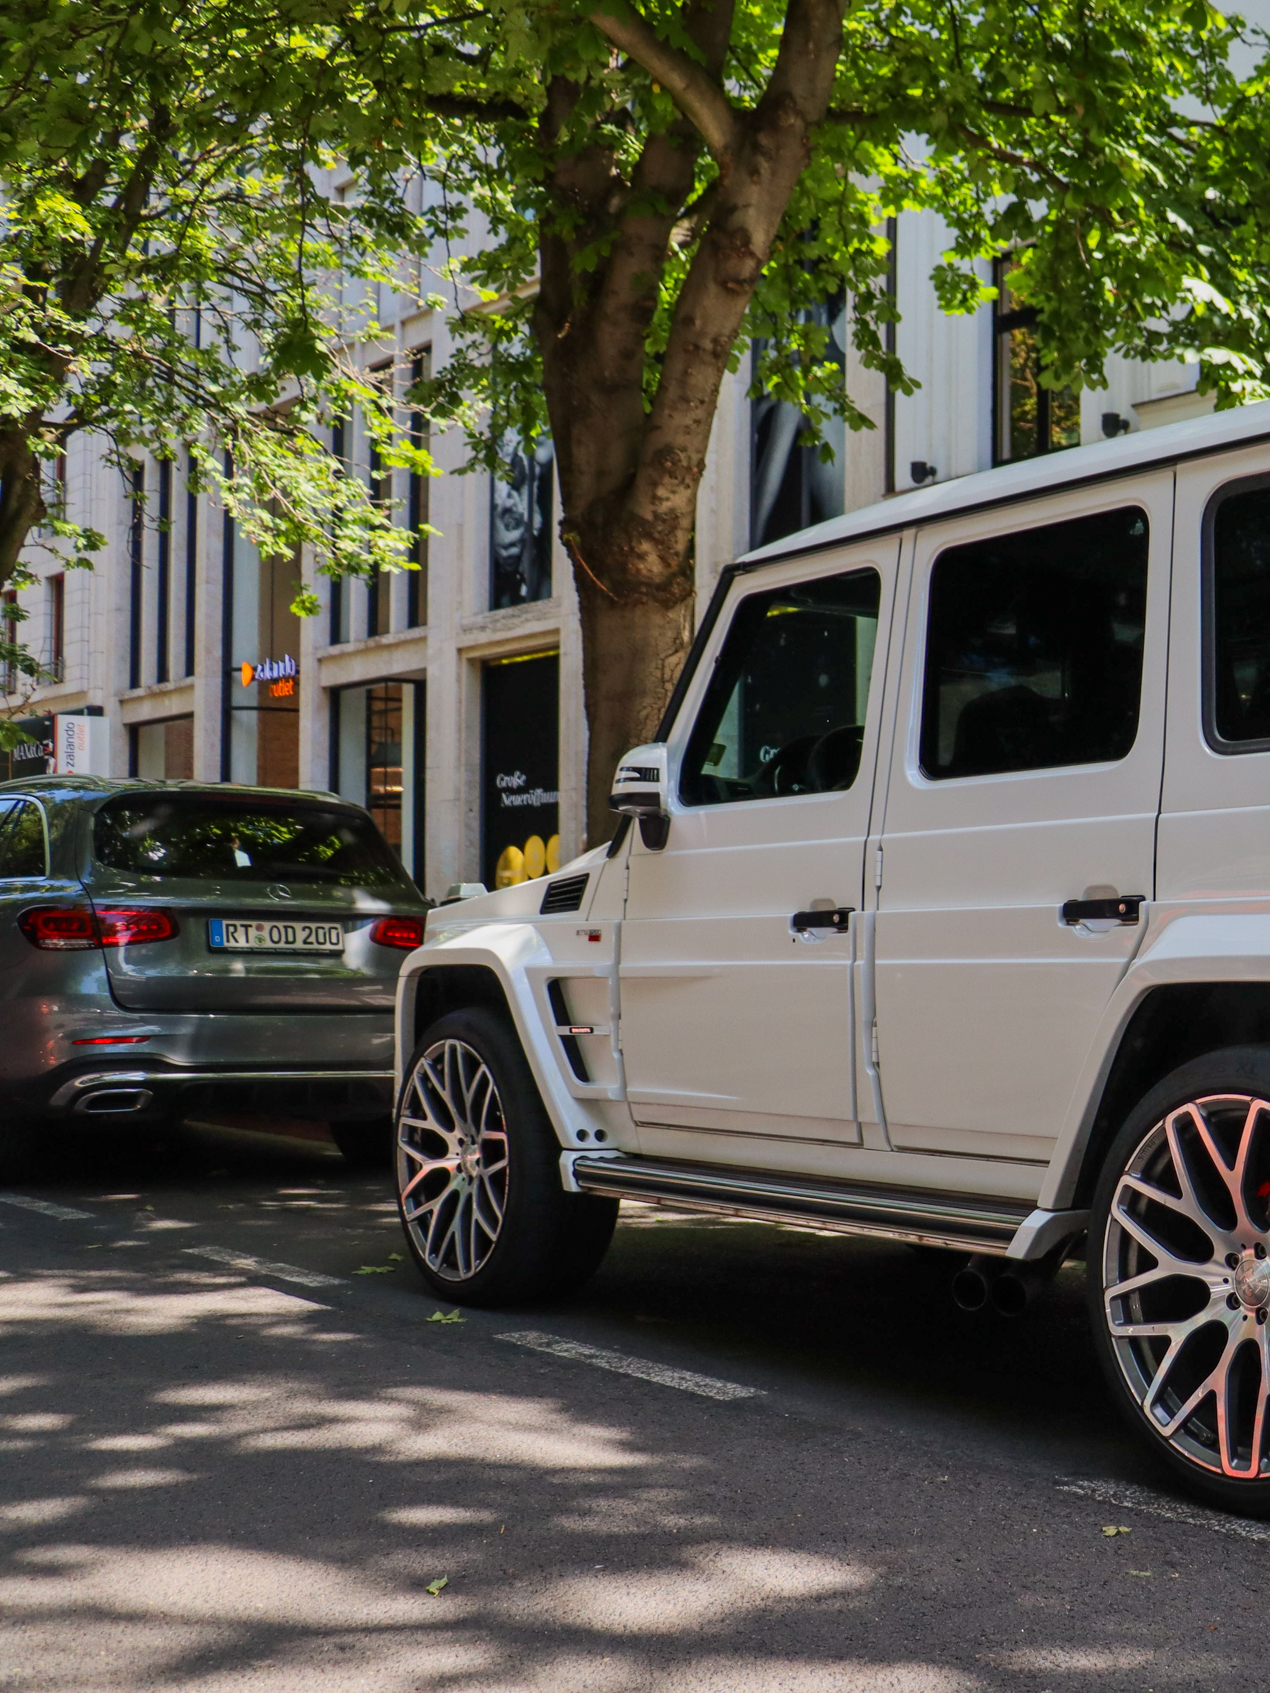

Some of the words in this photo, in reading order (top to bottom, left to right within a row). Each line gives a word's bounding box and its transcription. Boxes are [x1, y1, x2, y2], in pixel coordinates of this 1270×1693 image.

[64, 721, 76, 768] zalando
[225, 923, 253, 944] RT
[269, 924, 297, 945] OD
[301, 925, 340, 946] 200
